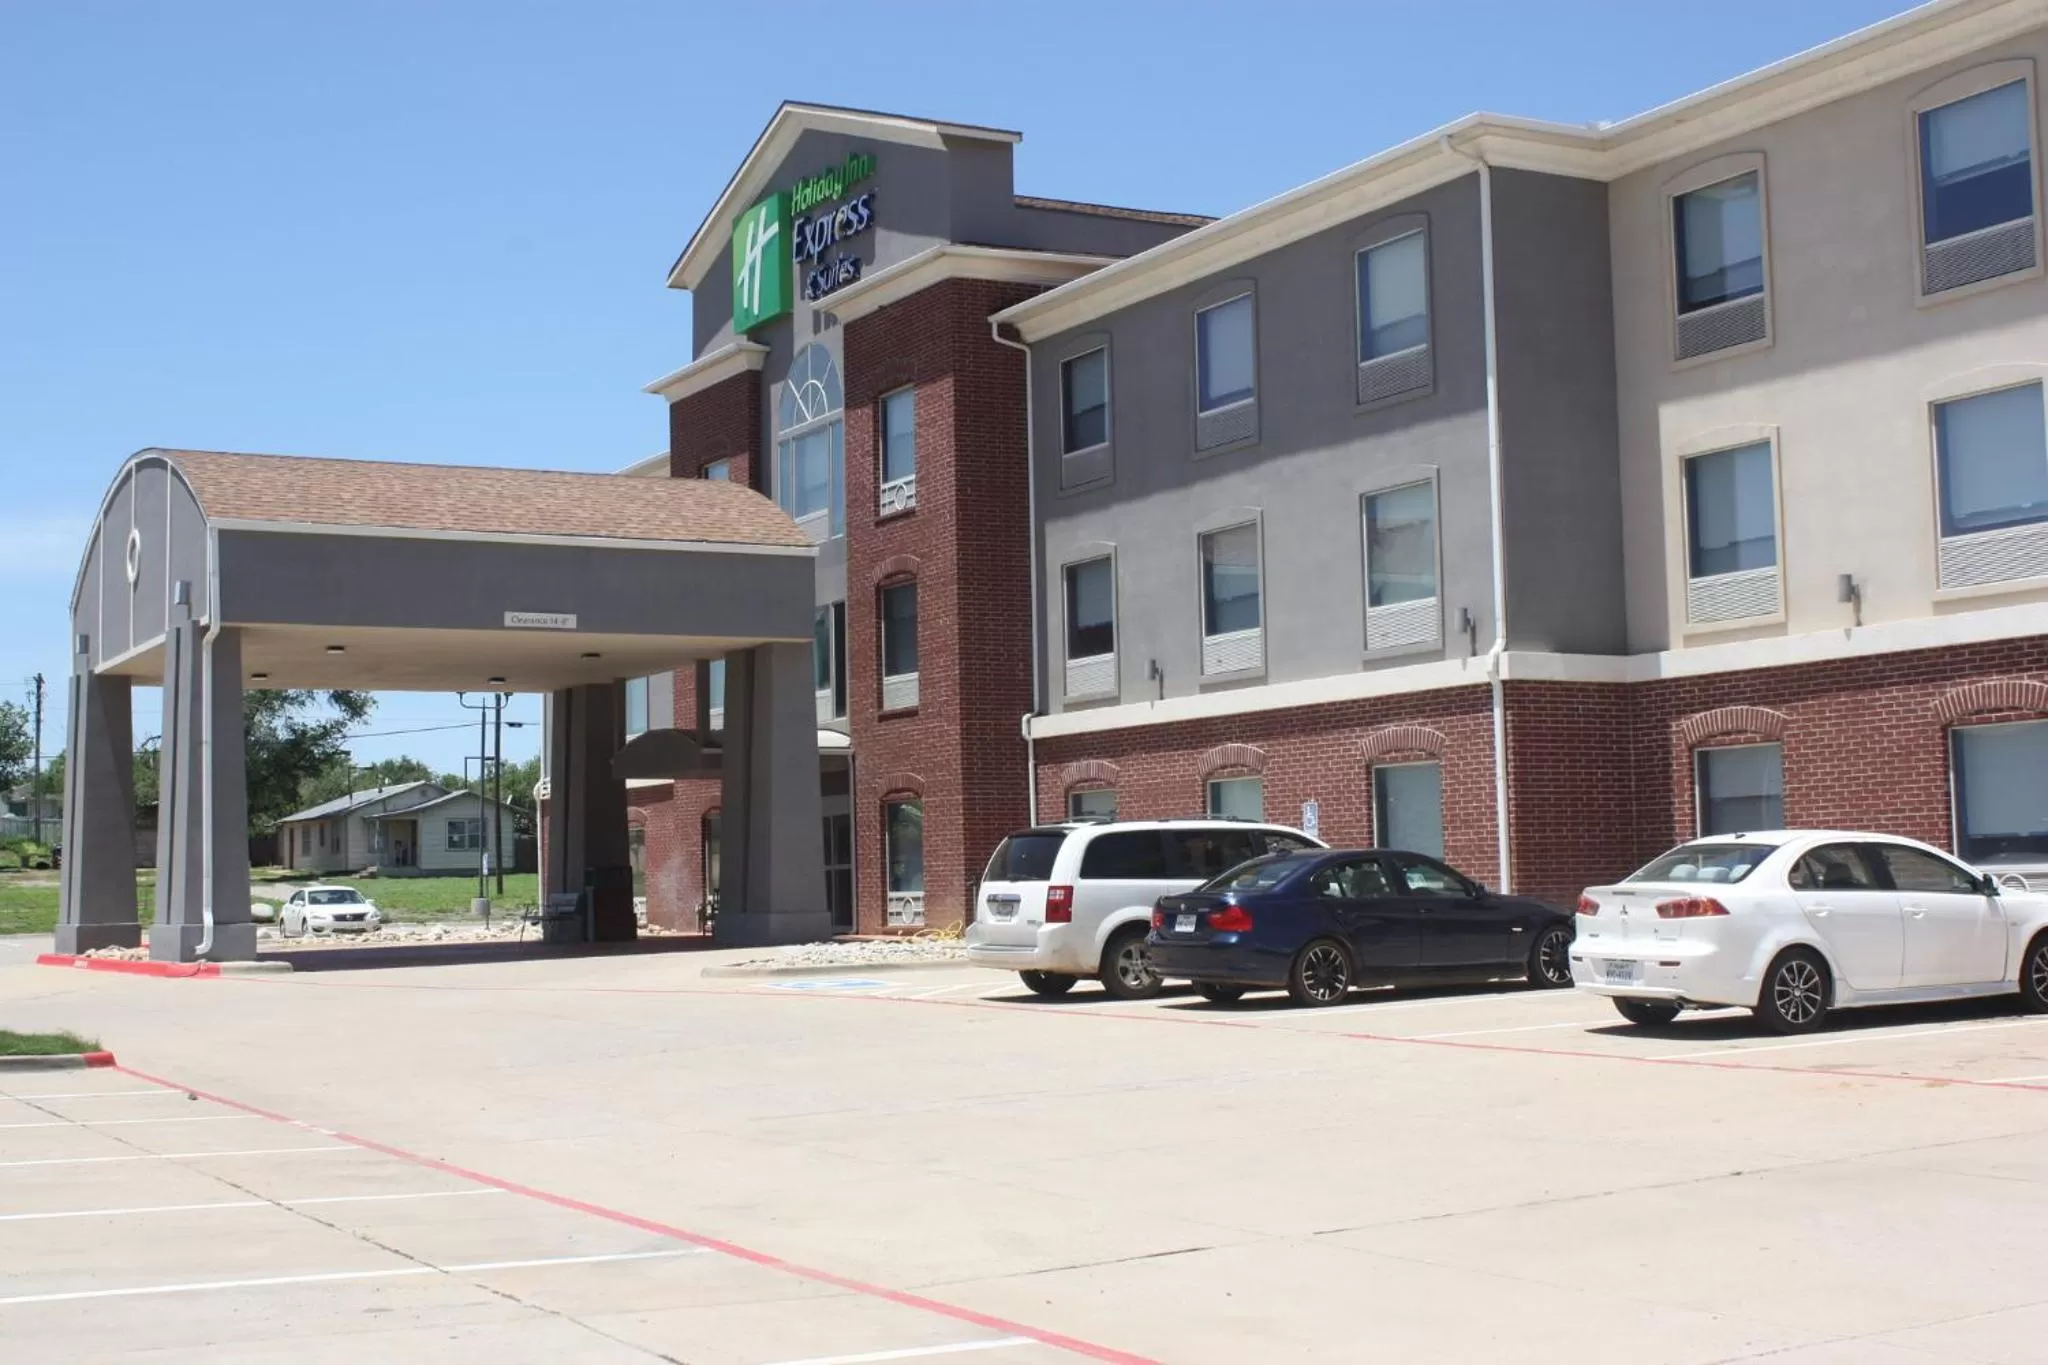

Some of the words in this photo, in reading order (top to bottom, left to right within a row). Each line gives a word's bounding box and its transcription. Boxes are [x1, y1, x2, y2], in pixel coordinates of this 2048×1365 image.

[791, 164, 843, 217] Holiday
[845, 151, 870, 185] Inn
[792, 192, 871, 265] Express
[816, 252, 856, 298] Suites
